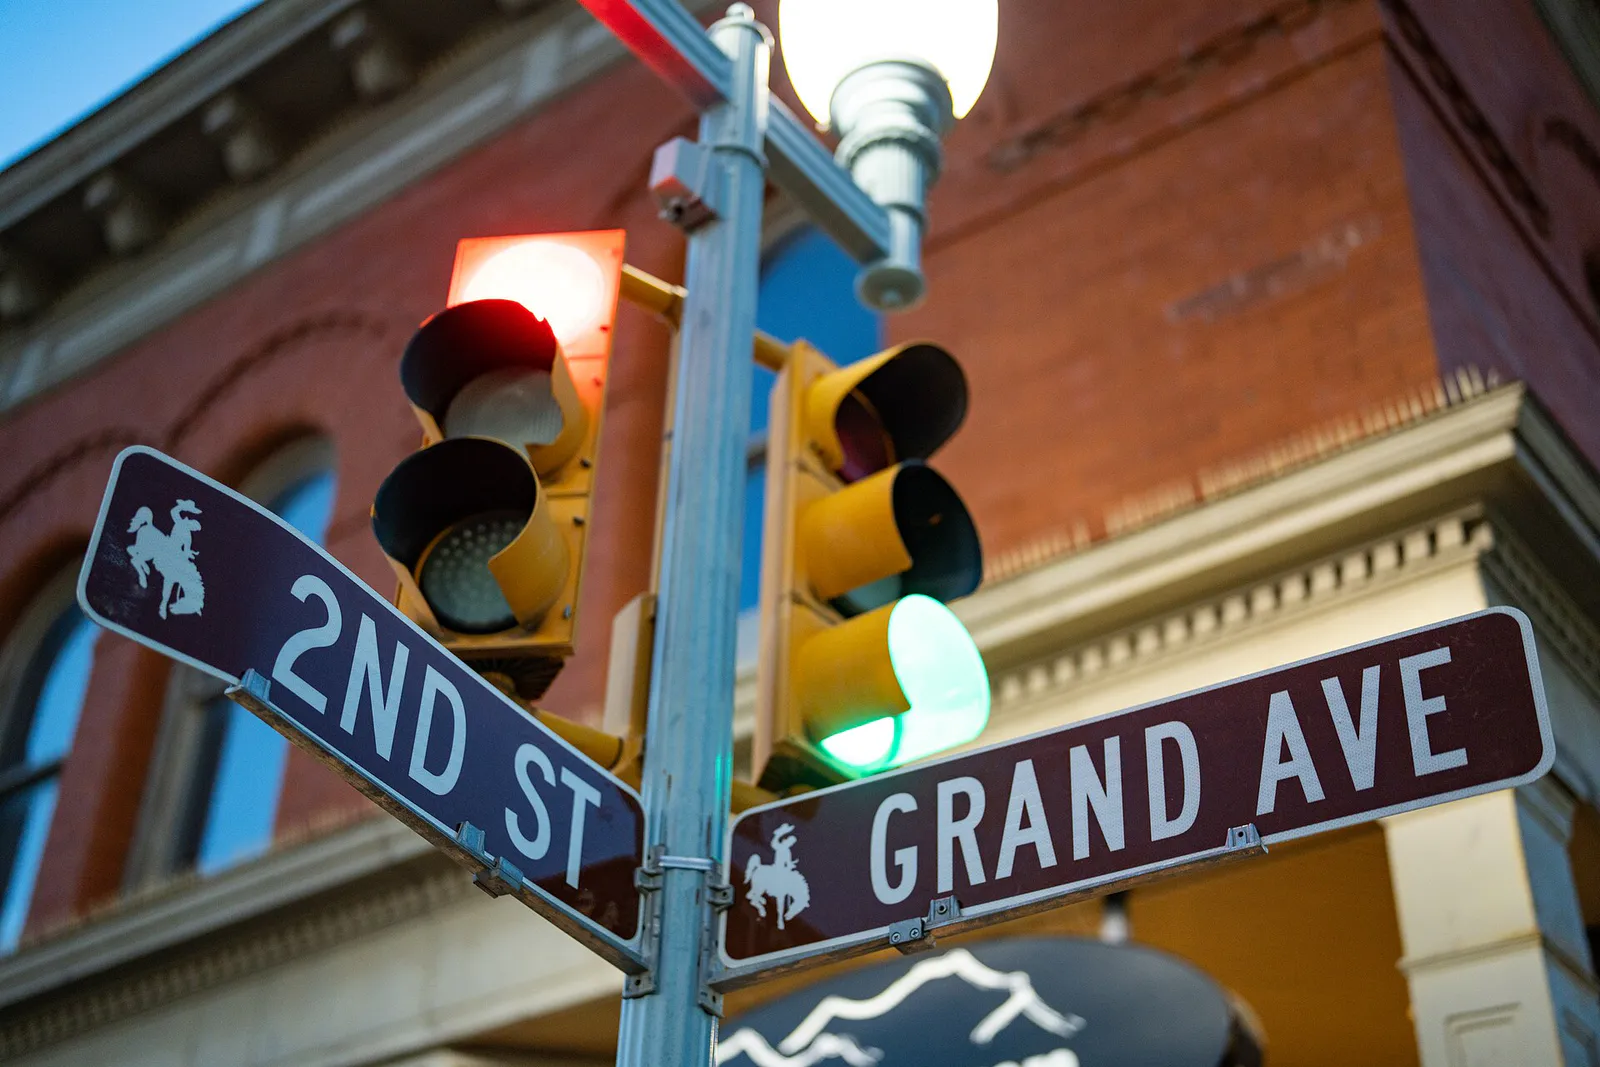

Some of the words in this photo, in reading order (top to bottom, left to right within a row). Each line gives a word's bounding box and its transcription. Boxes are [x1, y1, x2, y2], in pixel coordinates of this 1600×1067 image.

[271, 575, 467, 796] 2ND
[505, 744, 601, 890] ST
[871, 721, 1201, 905] GRAND
[1256, 646, 1468, 815] AVE
